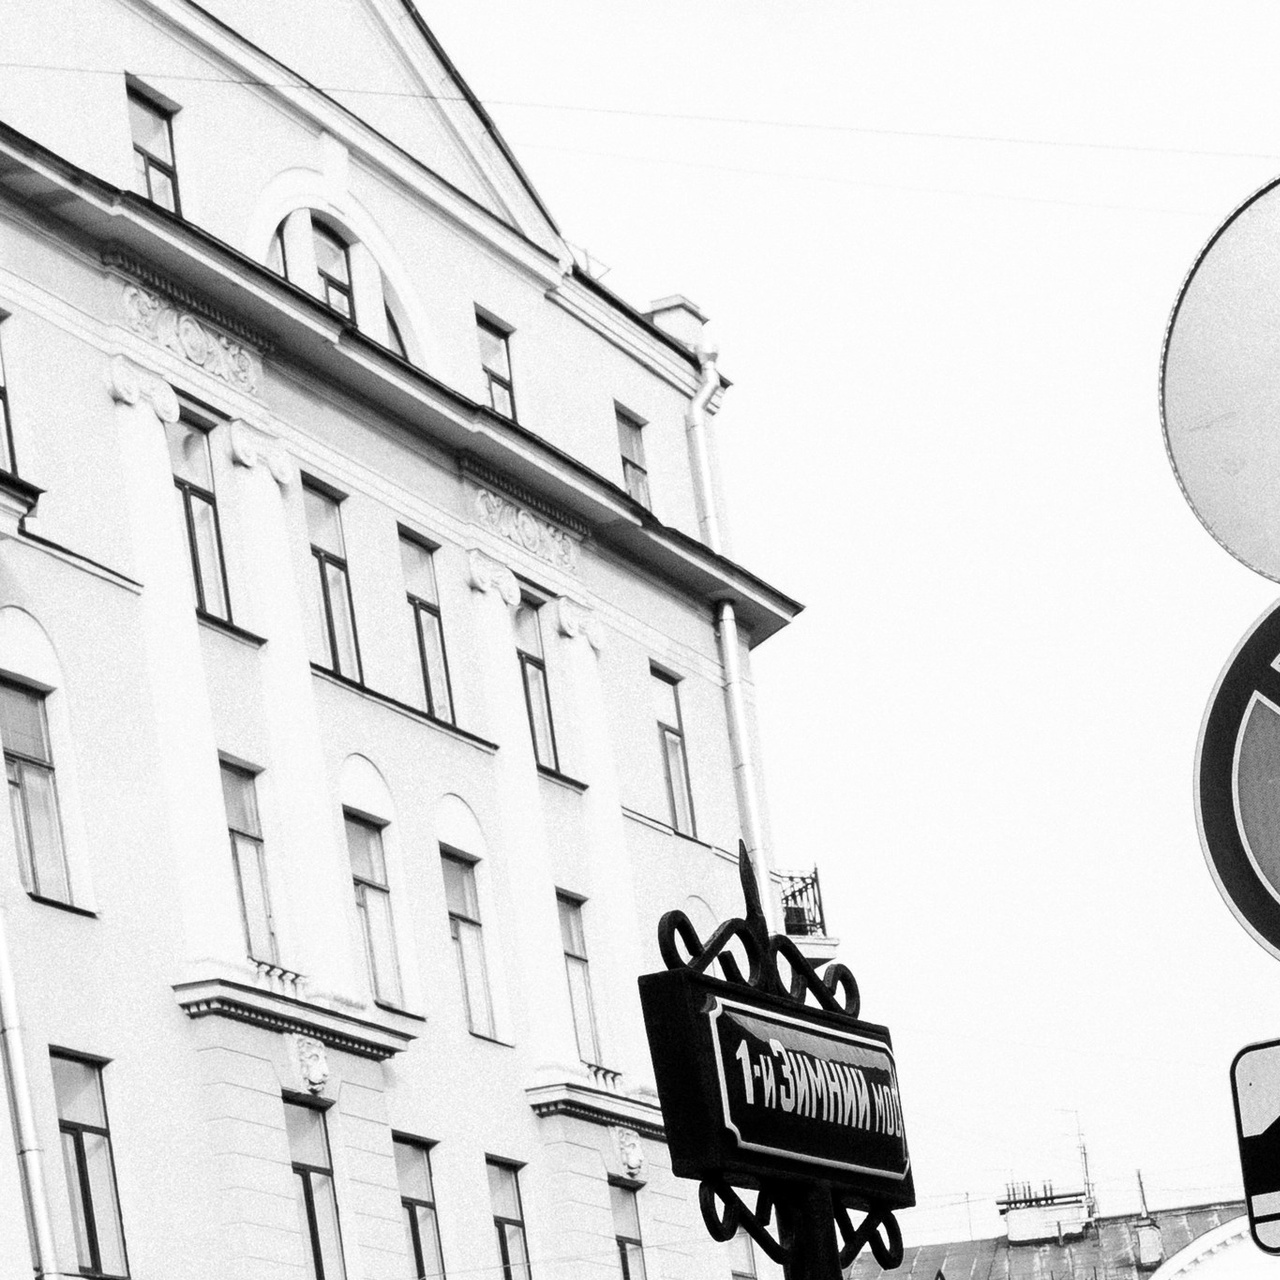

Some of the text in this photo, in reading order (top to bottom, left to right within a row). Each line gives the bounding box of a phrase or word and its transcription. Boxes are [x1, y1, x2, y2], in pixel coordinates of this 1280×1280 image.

[736, 1038, 902, 1137] 1-й Зимний мос
